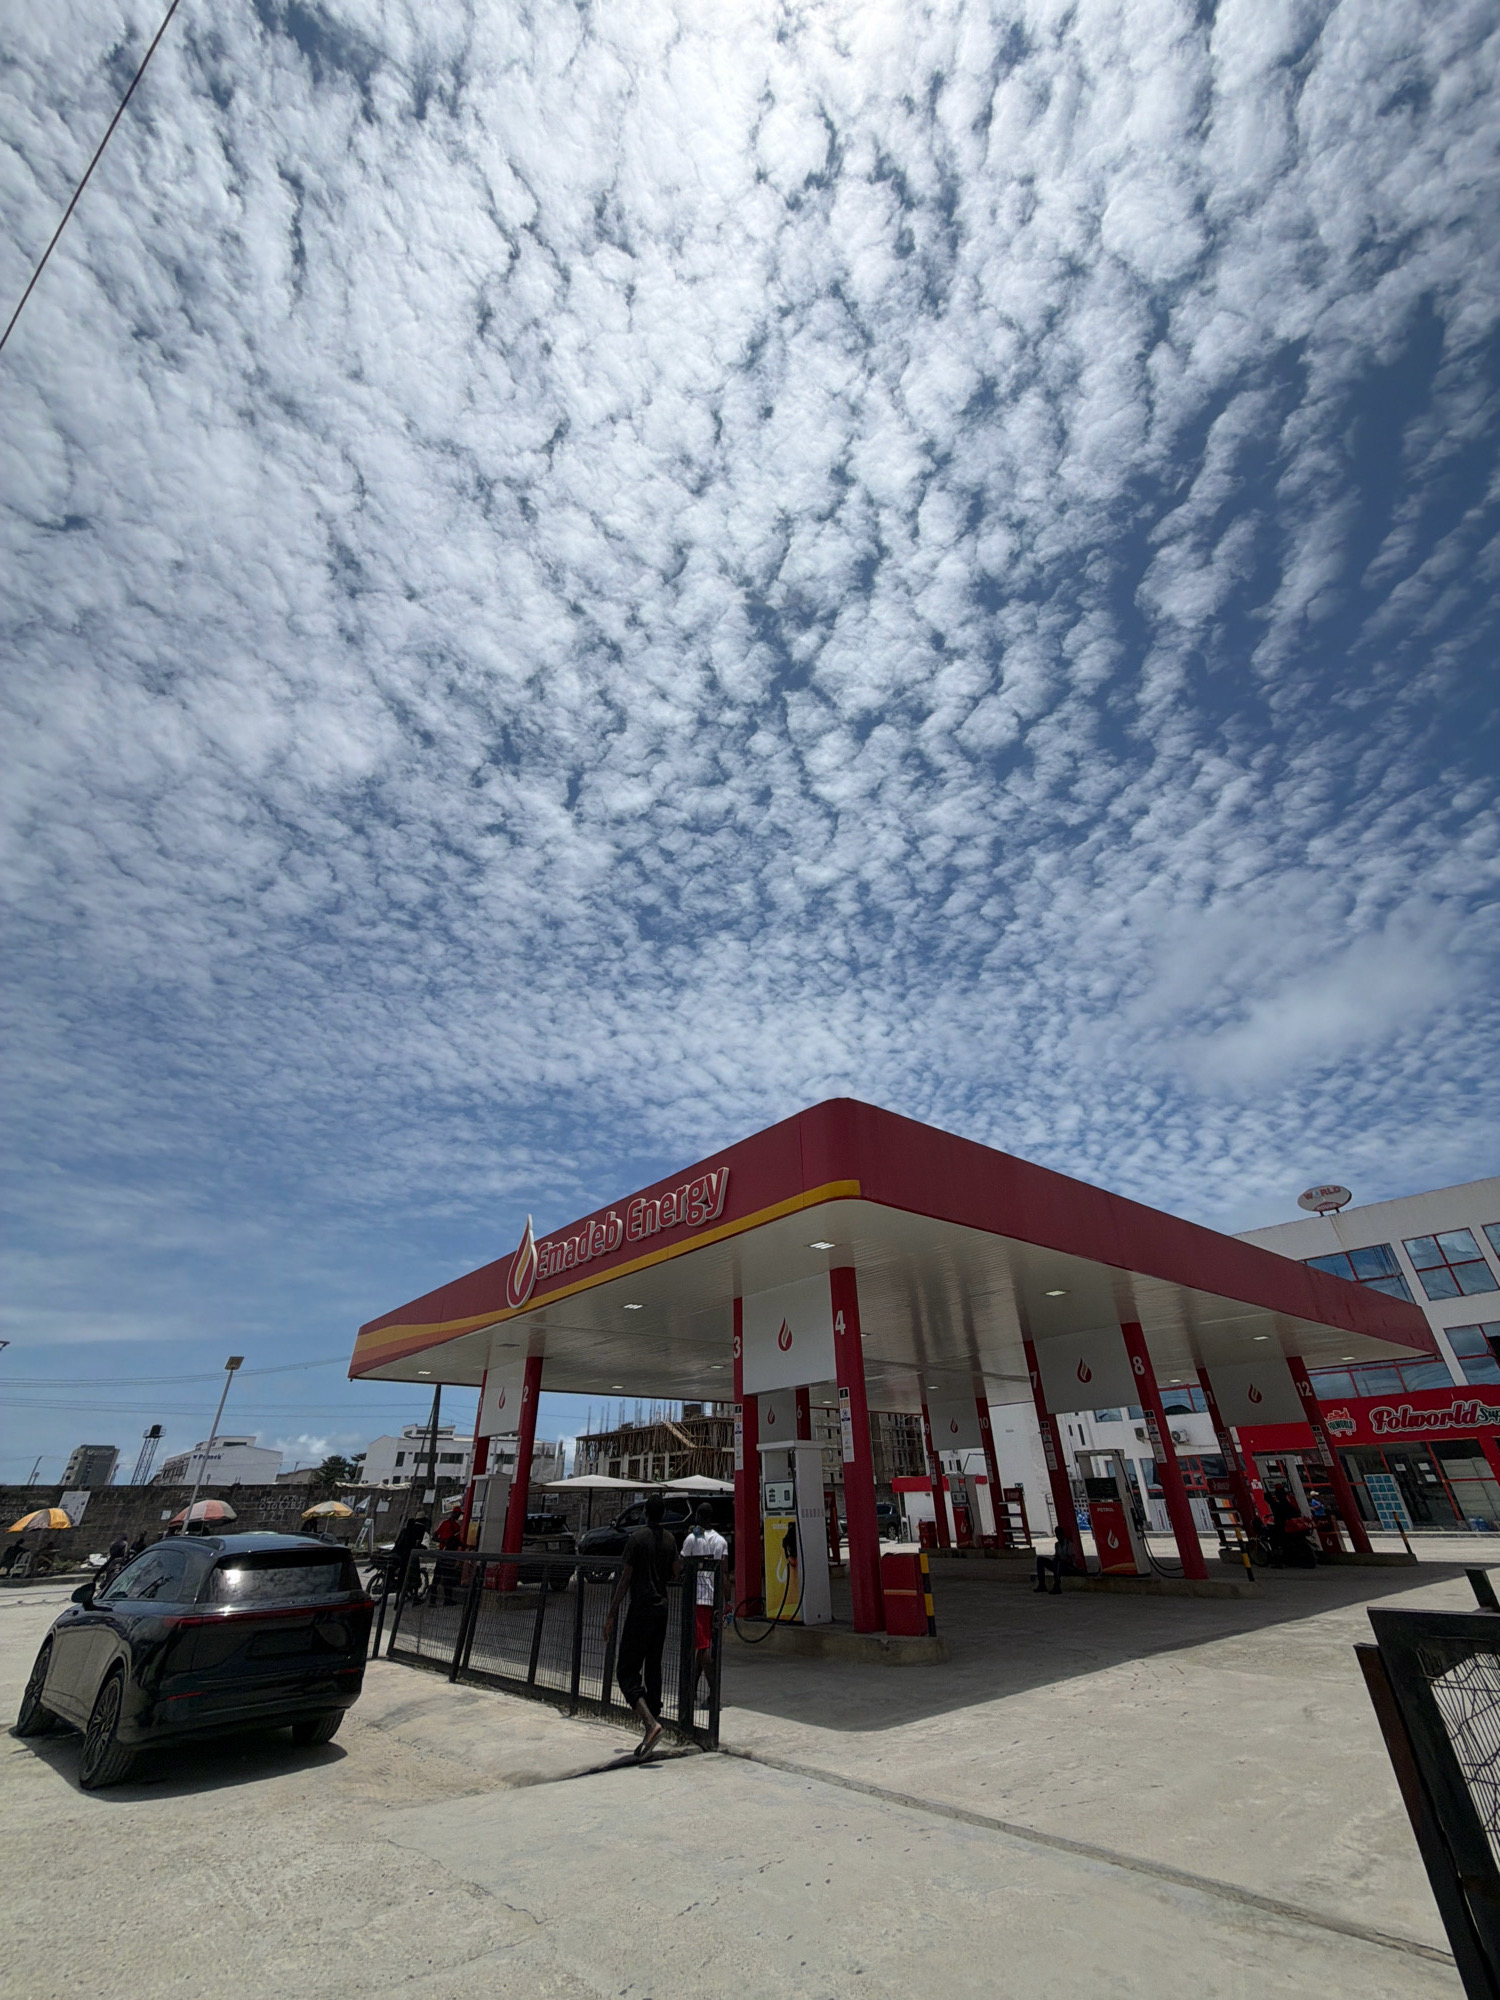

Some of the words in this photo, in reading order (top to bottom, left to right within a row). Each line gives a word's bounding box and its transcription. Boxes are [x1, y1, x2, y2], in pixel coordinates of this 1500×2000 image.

[536, 1211, 623, 1280] Emadeb
[626, 1167, 729, 1242] Energy
[835, 1310, 846, 1335] 4
[733, 1336, 741, 1359] 3
[1132, 1356, 1145, 1375] 8
[1029, 1371, 1038, 1389] 7
[1296, 1381, 1312, 1397] 12
[522, 1385, 530, 1403] 2
[797, 1405, 803, 1419] 6
[1371, 1401, 1480, 1432] Folworld
[925, 1423, 930, 1434] 9
[978, 1416, 989, 1430] 10
